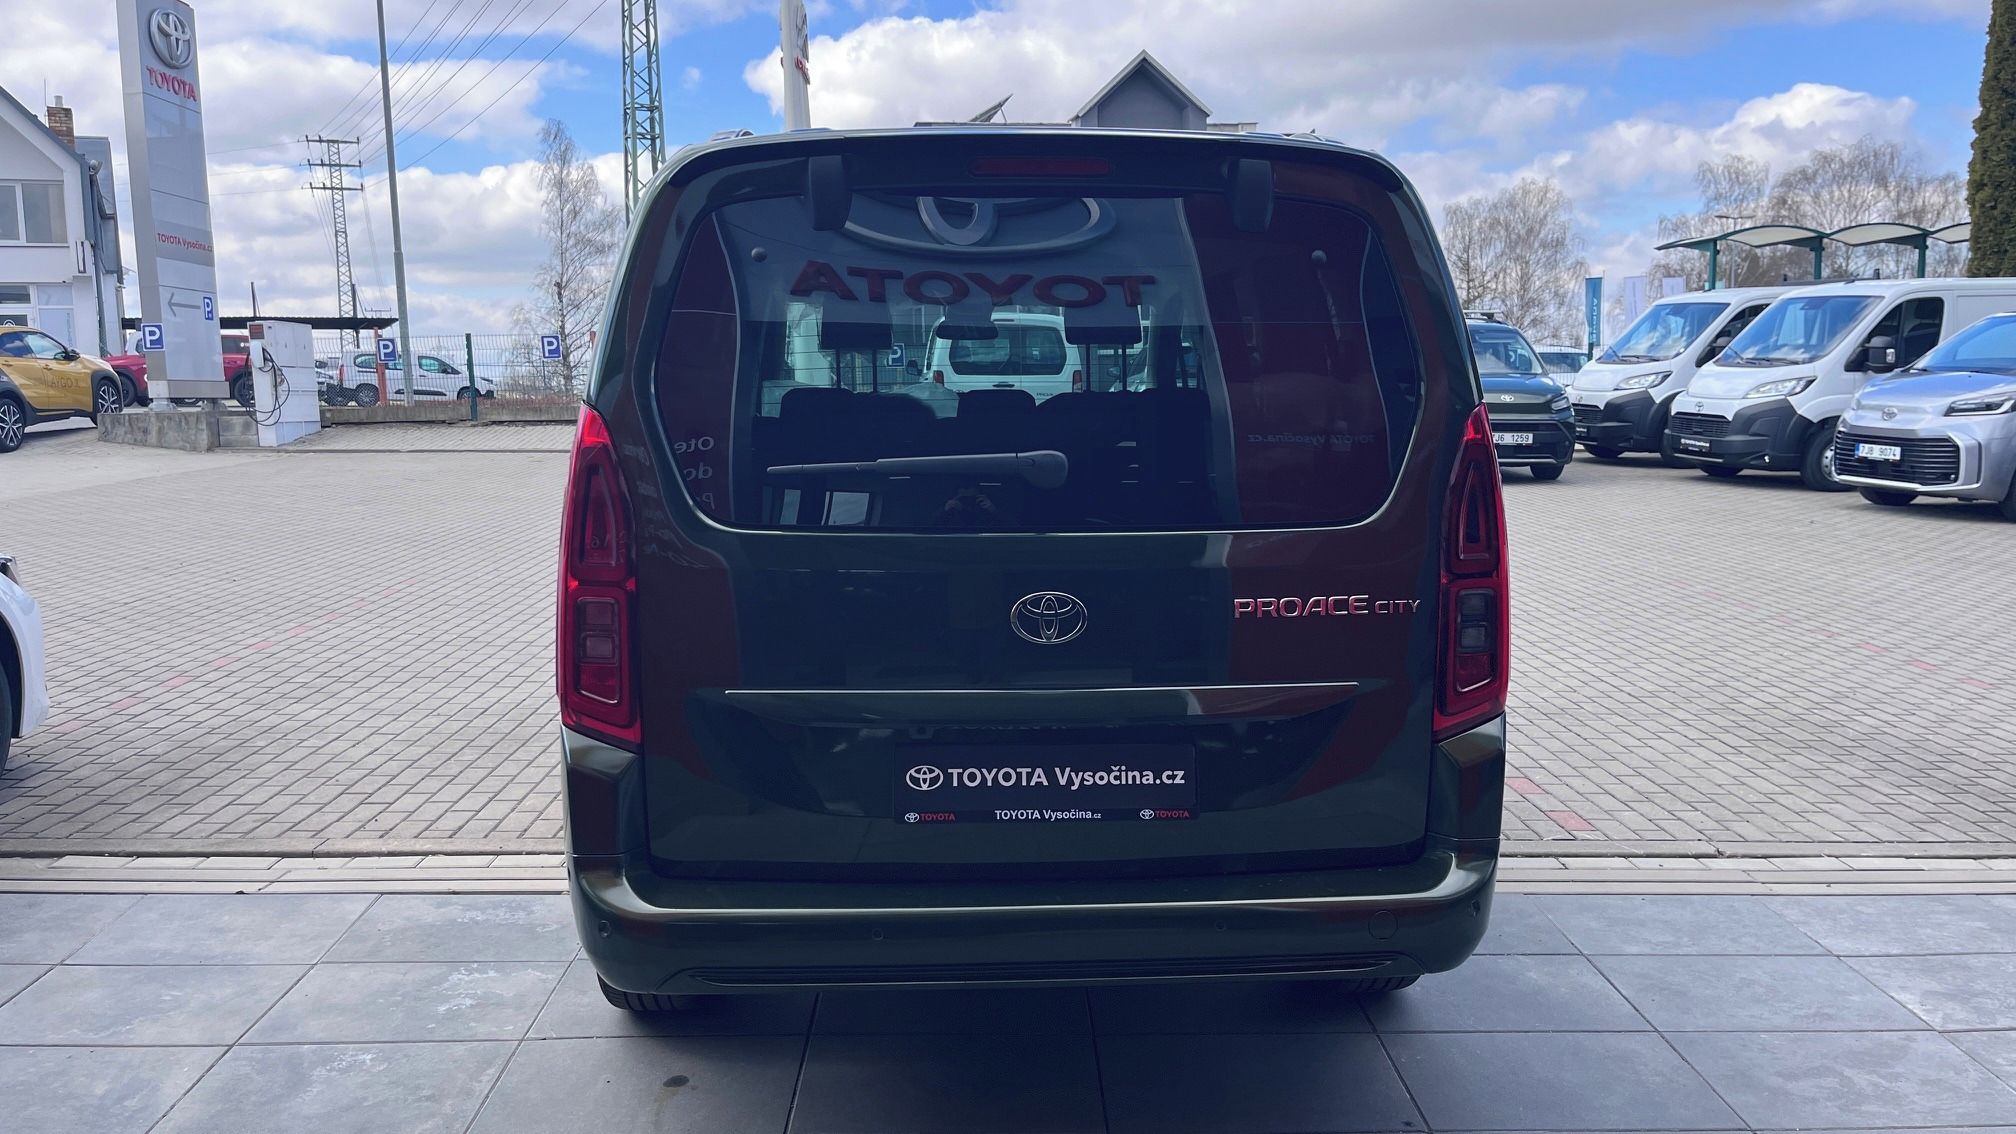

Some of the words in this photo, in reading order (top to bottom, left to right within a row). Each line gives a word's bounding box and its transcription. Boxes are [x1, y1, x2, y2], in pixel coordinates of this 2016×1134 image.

[146, 65, 198, 102] TOYOTA
[157, 232, 182, 247] TOYOTA
[204, 298, 212, 318] P
[145, 327, 160, 347] P
[543, 337, 558, 356] P
[379, 340, 394, 359] P
[1512, 434, 1530, 442] 1259
[1234, 595, 1369, 618] PROACE
[1374, 600, 1421, 614] CITY
[947, 767, 1049, 787] TOYOTA
[1055, 765, 1186, 791] Vysočina.cz
[920, 812, 956, 822] TOYOTA
[994, 809, 1041, 820] TOYOTA
[1042, 808, 1102, 822] Vysočina.cz
[1155, 809, 1190, 819] TOYOTA
